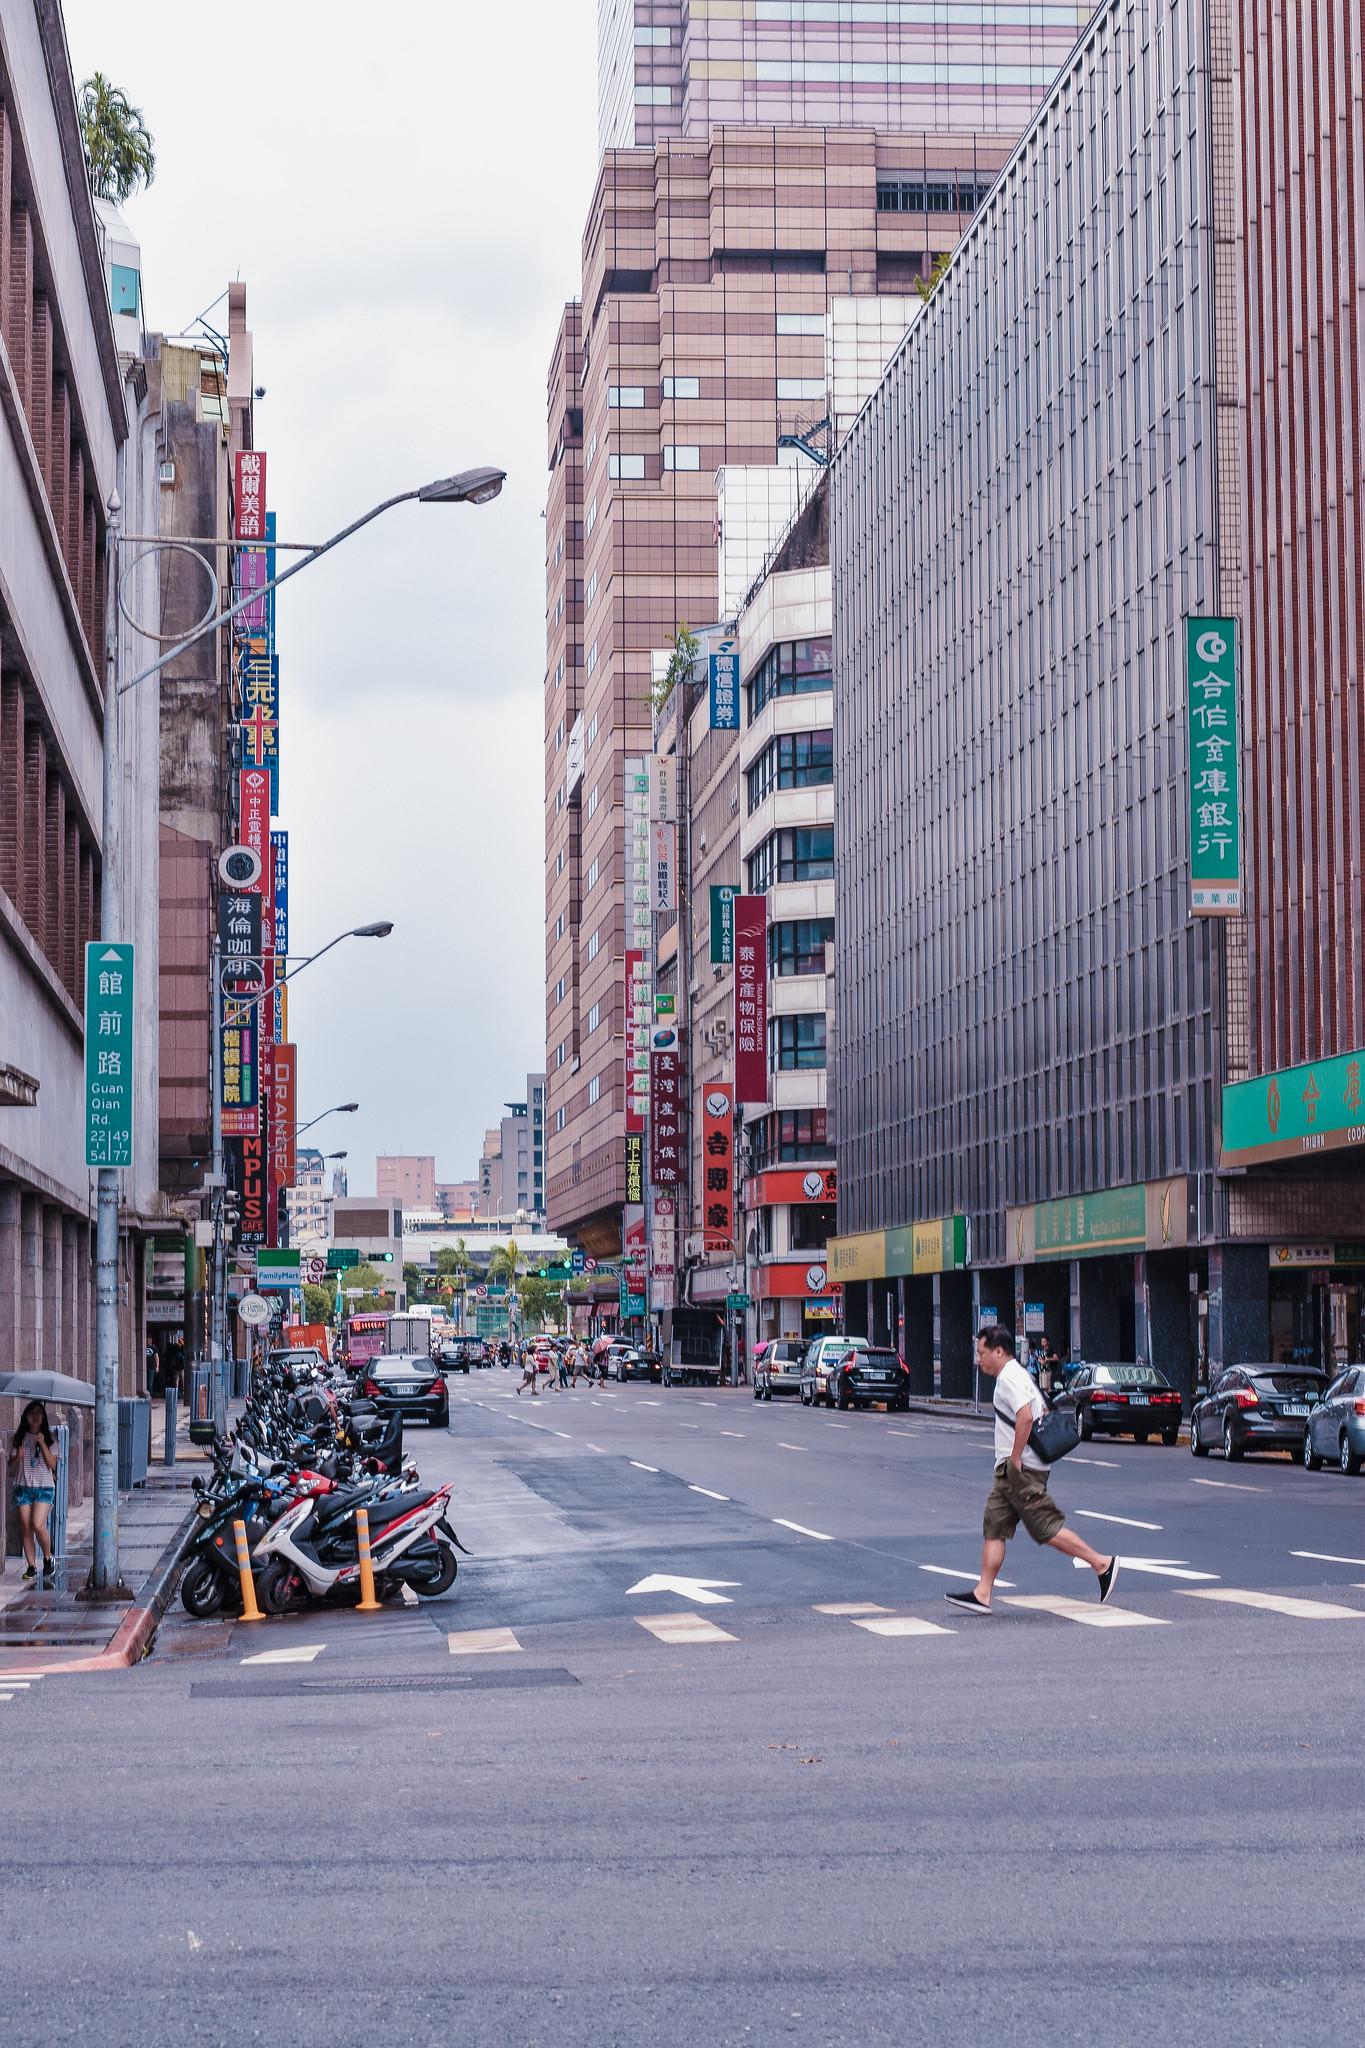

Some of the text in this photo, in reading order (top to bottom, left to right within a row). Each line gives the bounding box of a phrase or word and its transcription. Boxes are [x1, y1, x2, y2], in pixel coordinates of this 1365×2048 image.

[240, 454, 260, 536] 戴爾美語
[715, 656, 734, 720] 德信證券
[1192, 670, 1233, 860] 合作金庫銀行
[1193, 892, 1238, 904] 營業部
[227, 897, 252, 976] 海倫咖啡
[739, 946, 755, 1053] 泰安產物保險
[98, 971, 123, 1076] 館前路
[91, 1083, 124, 1094] Guan
[91, 1098, 120, 1109] Qian
[91, 1114, 111, 1125] Rd.
[275, 1063, 291, 1168] ORANGE
[660, 1055, 676, 1181] 臺灣產物保險
[91, 1131, 129, 1142] 22 49
[1303, 1133, 1325, 1151] TAIWAN
[91, 1150, 129, 1161] 54 77
[707, 1241, 730, 1251] 24H
[258, 1271, 299, 1281] FamilyMart
